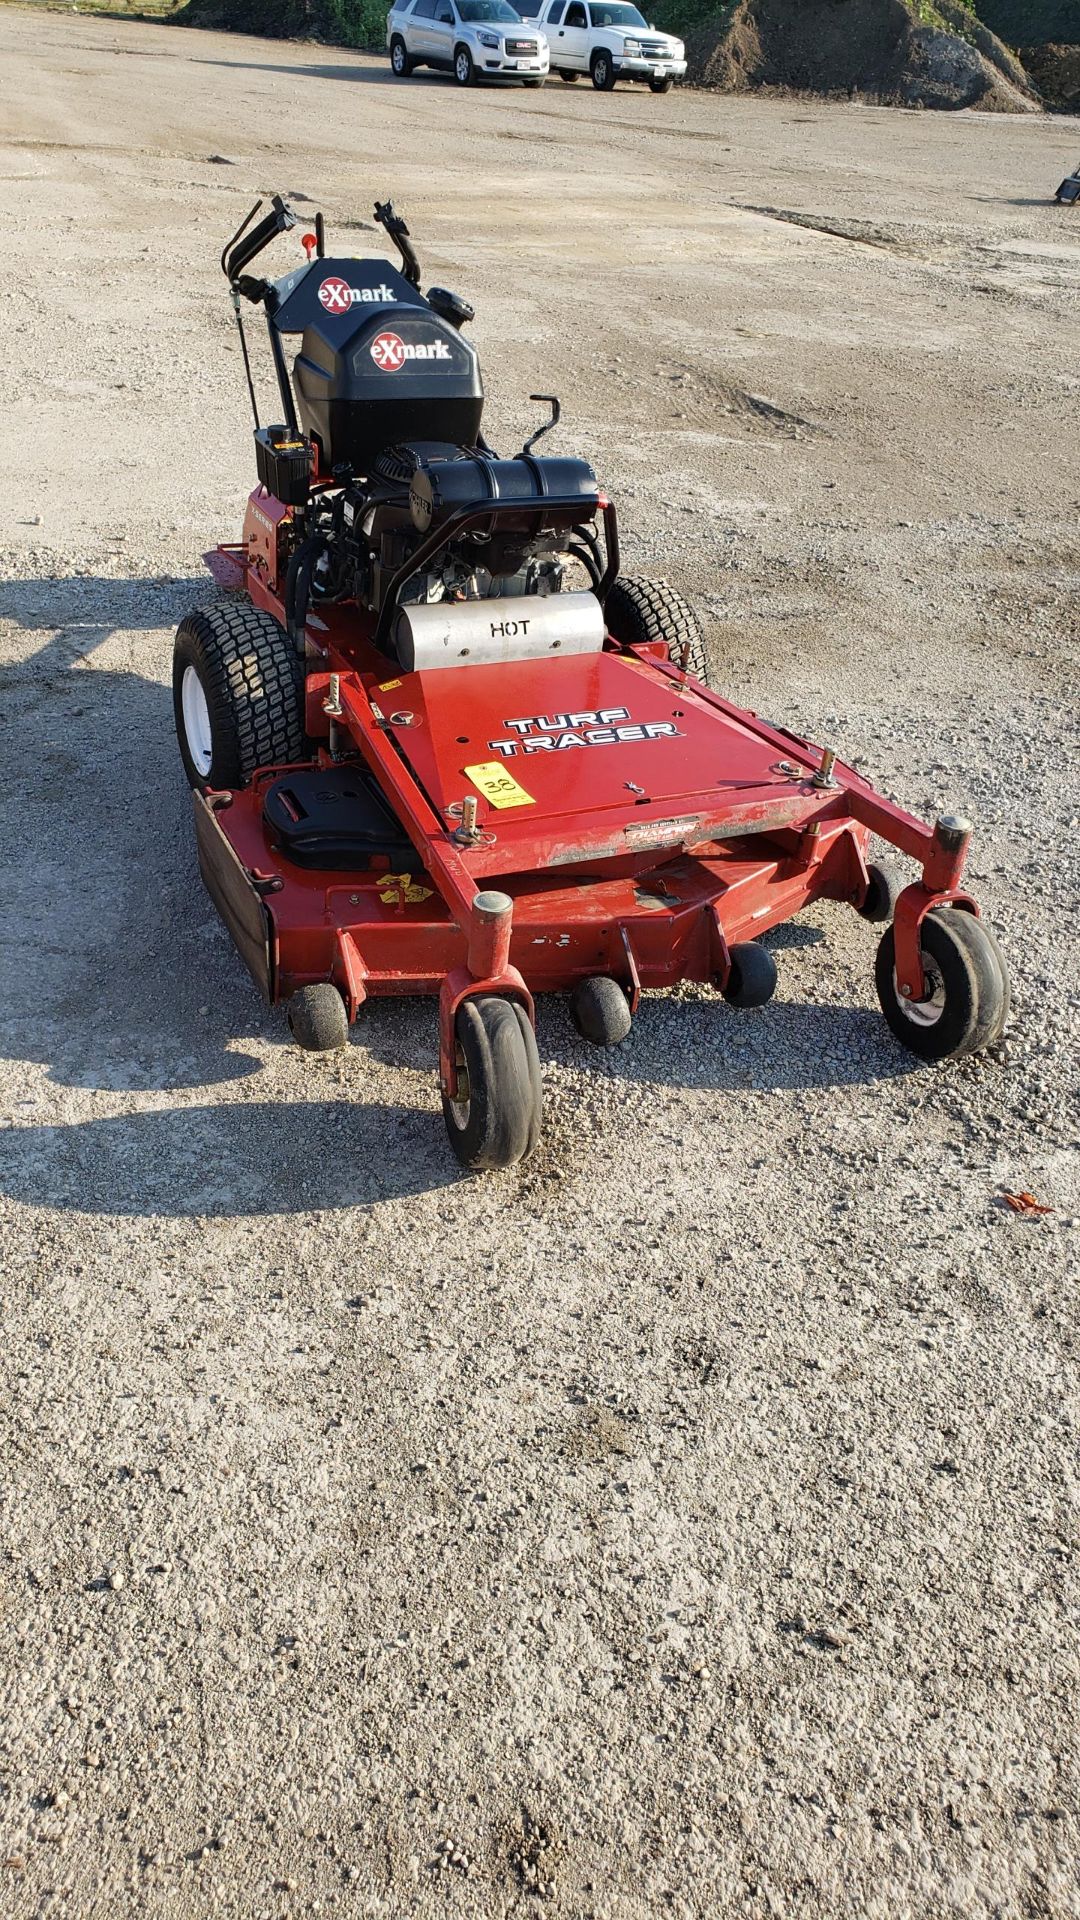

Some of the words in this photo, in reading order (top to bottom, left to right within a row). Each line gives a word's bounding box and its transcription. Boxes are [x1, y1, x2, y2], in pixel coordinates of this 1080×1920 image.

[490, 620, 530, 637] HOT
[504, 707, 630, 734] TURF
[488, 721, 682, 757] TRACER
[484, 779, 516, 793] 38
